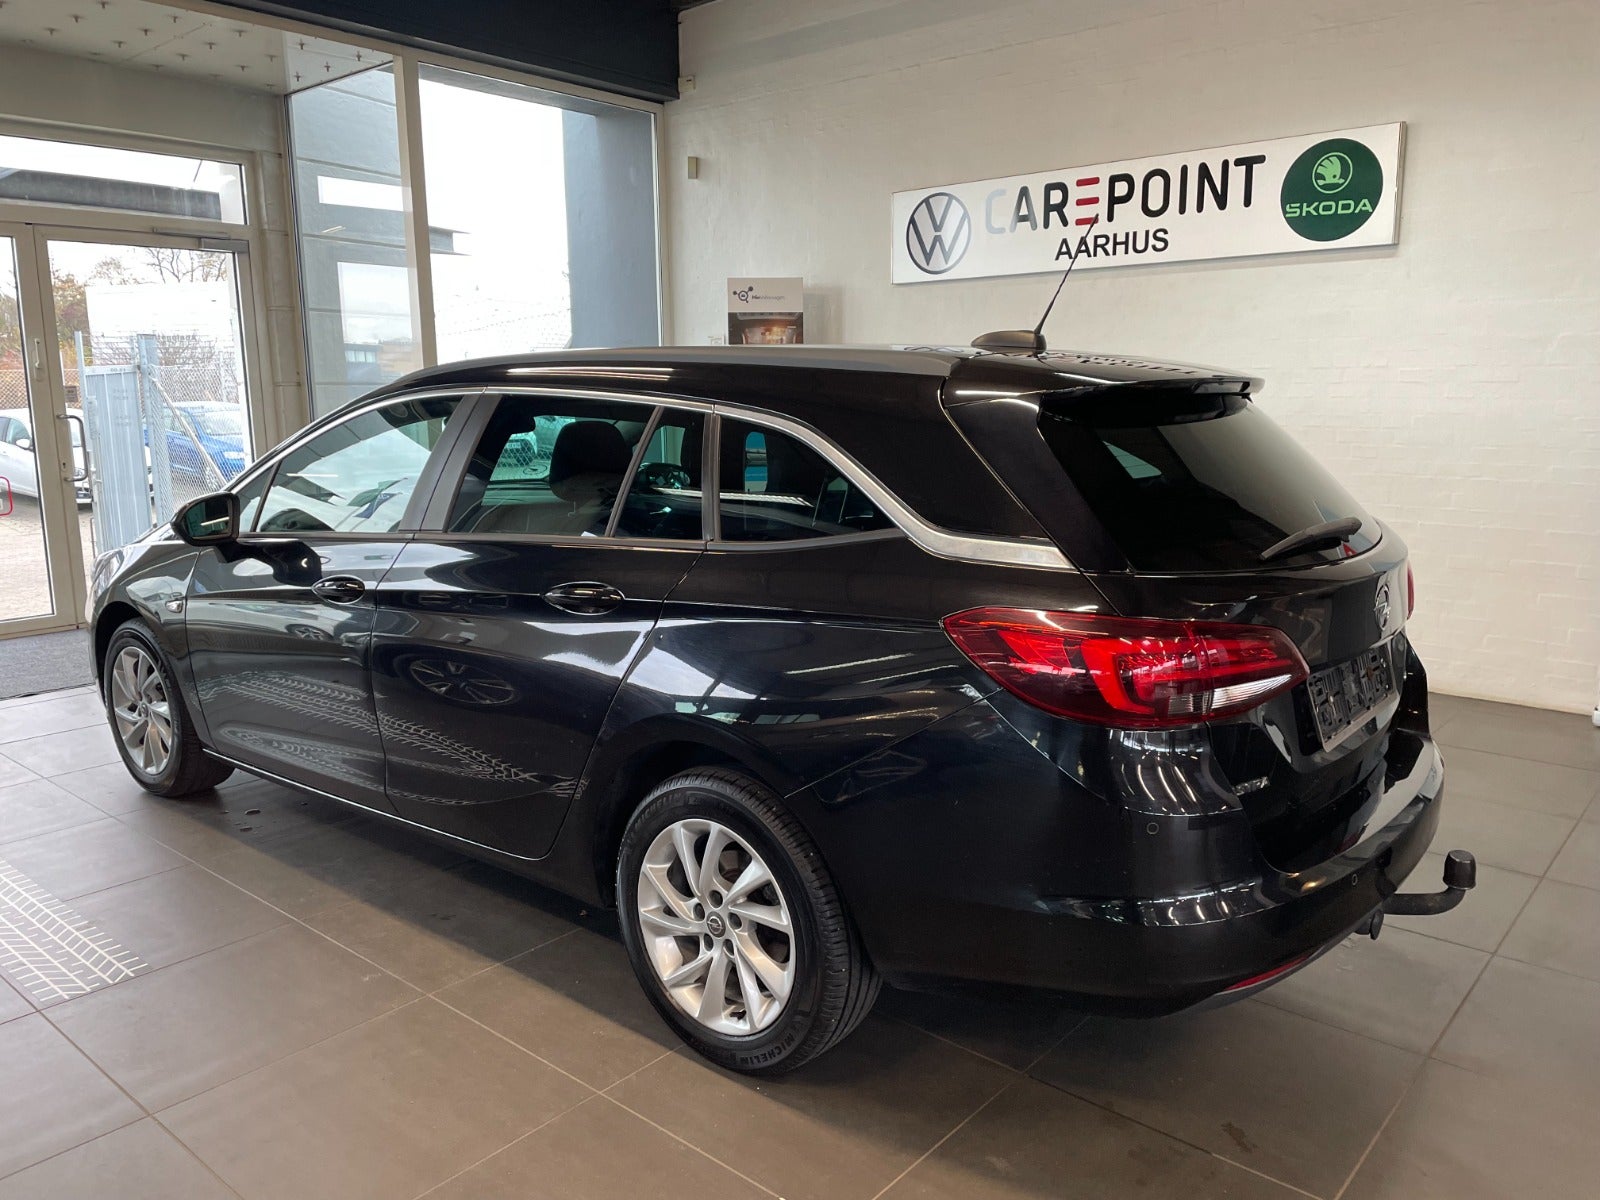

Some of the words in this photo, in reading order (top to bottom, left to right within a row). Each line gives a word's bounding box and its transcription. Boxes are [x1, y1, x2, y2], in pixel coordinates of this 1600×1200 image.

[985, 155, 1266, 235] CAREPOINT
[1055, 228, 1169, 260] AARHUS
[740, 1032, 795, 1065] MICHELIN
